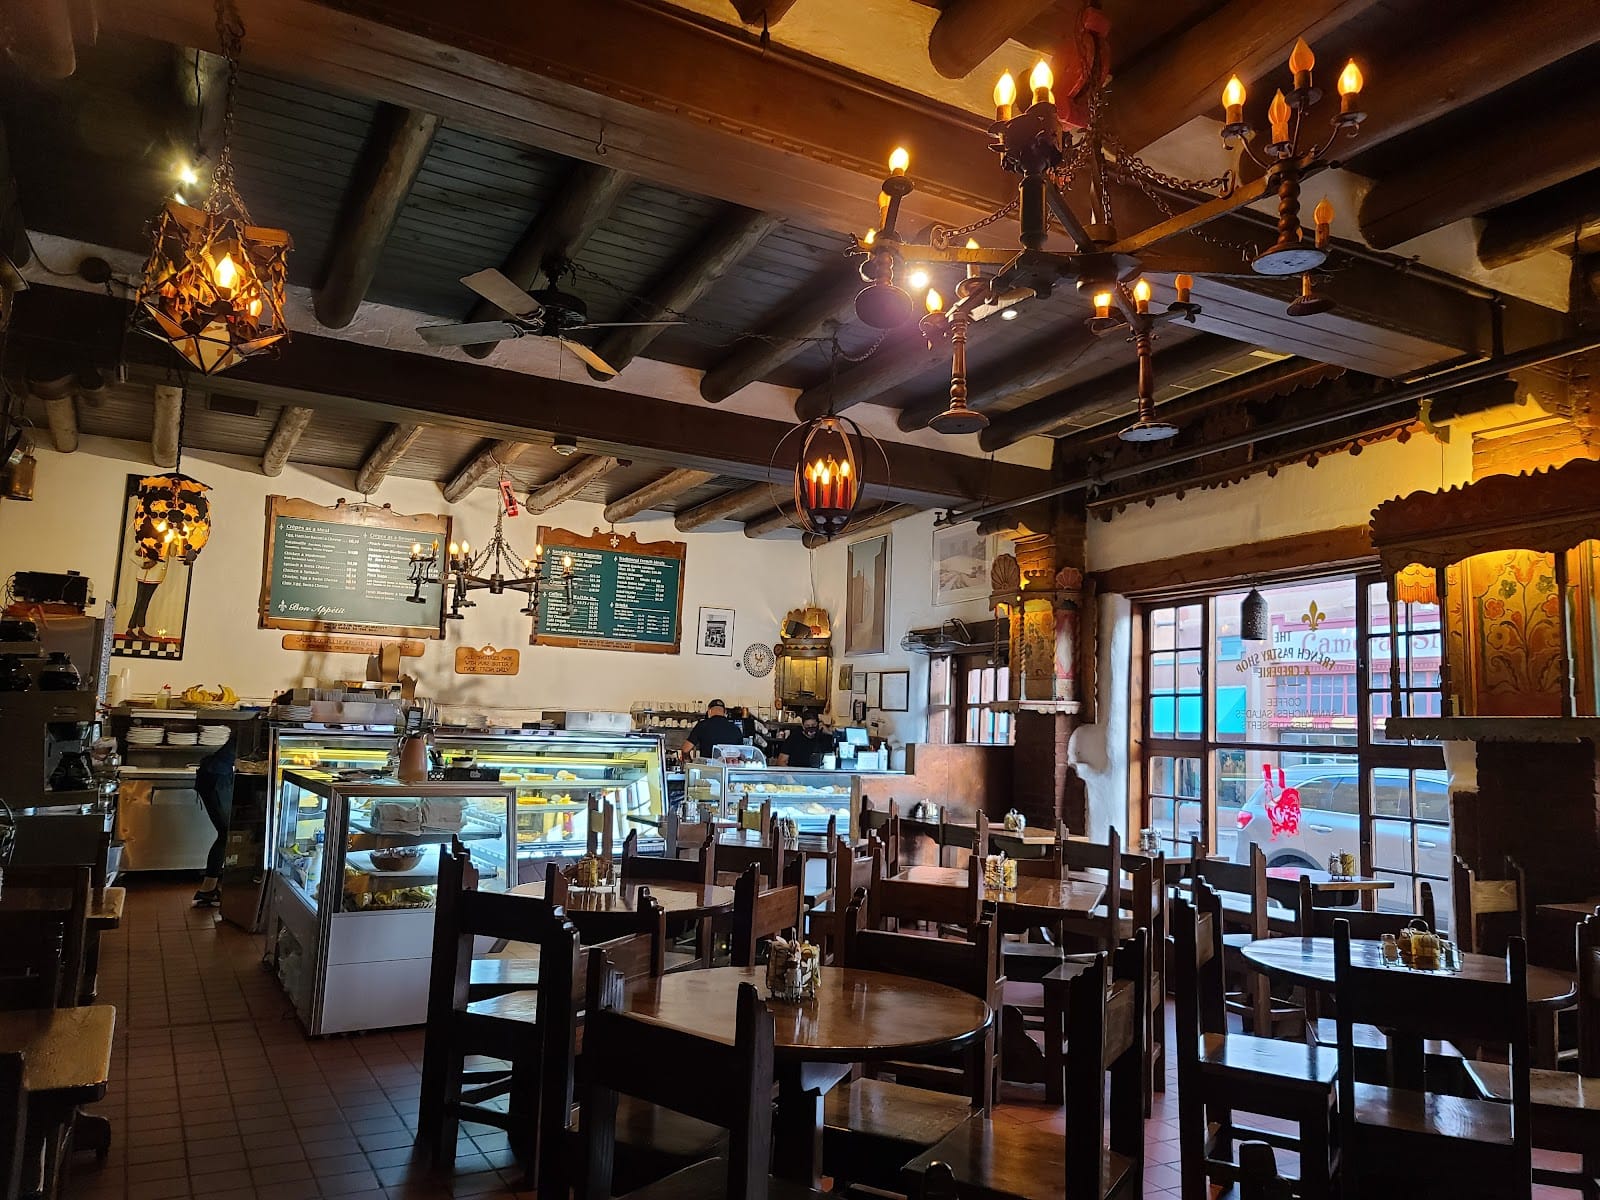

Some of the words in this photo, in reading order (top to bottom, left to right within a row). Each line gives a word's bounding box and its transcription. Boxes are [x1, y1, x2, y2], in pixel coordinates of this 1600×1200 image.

[288, 602, 310, 612] Bon
[311, 604, 345, 616] Appétit
[1302, 632, 1391, 655] Cama
